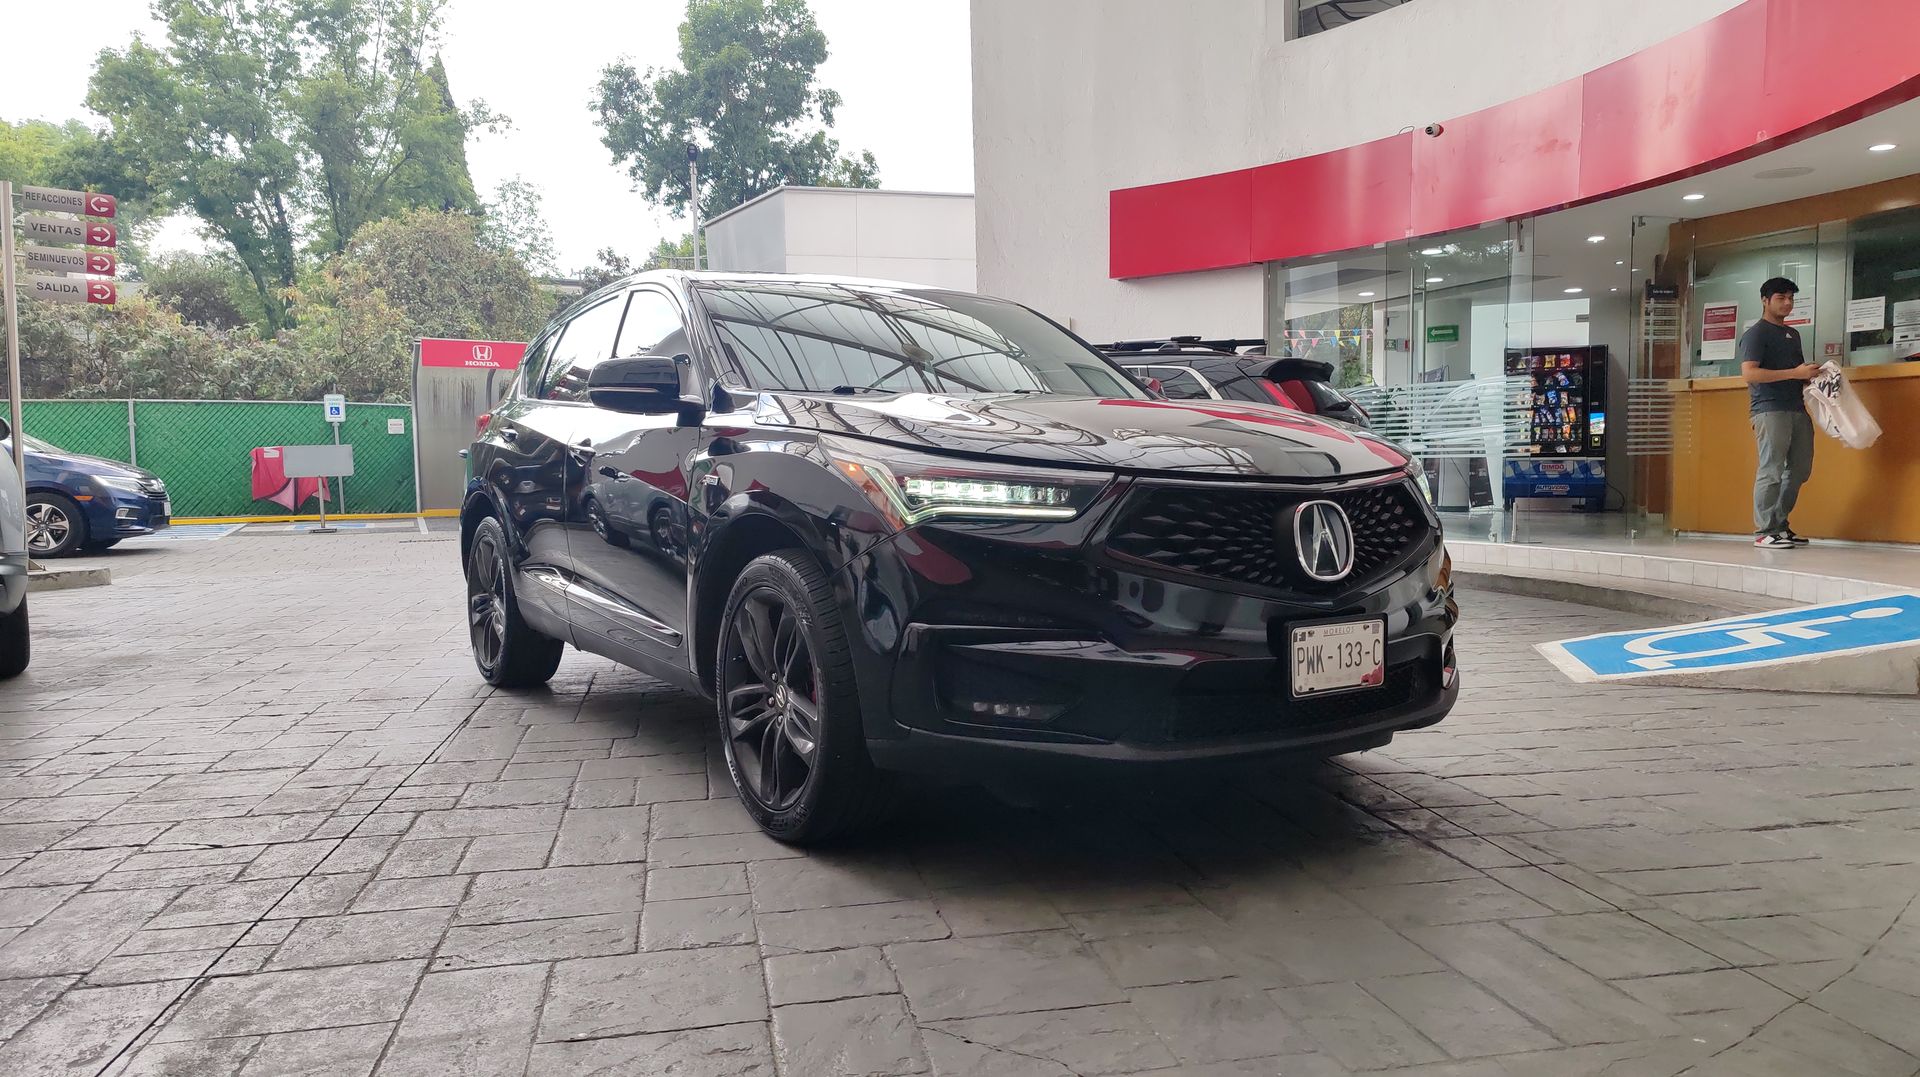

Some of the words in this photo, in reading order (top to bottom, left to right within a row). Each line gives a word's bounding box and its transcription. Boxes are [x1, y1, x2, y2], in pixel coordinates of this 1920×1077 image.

[25, 192, 83, 207] REFACCIONES
[30, 222, 82, 236] VENTAS
[28, 252, 85, 266] SEMINUEVOS
[36, 282, 79, 294] SALIDA
[1297, 638, 1381, 677] PWK-133-C
